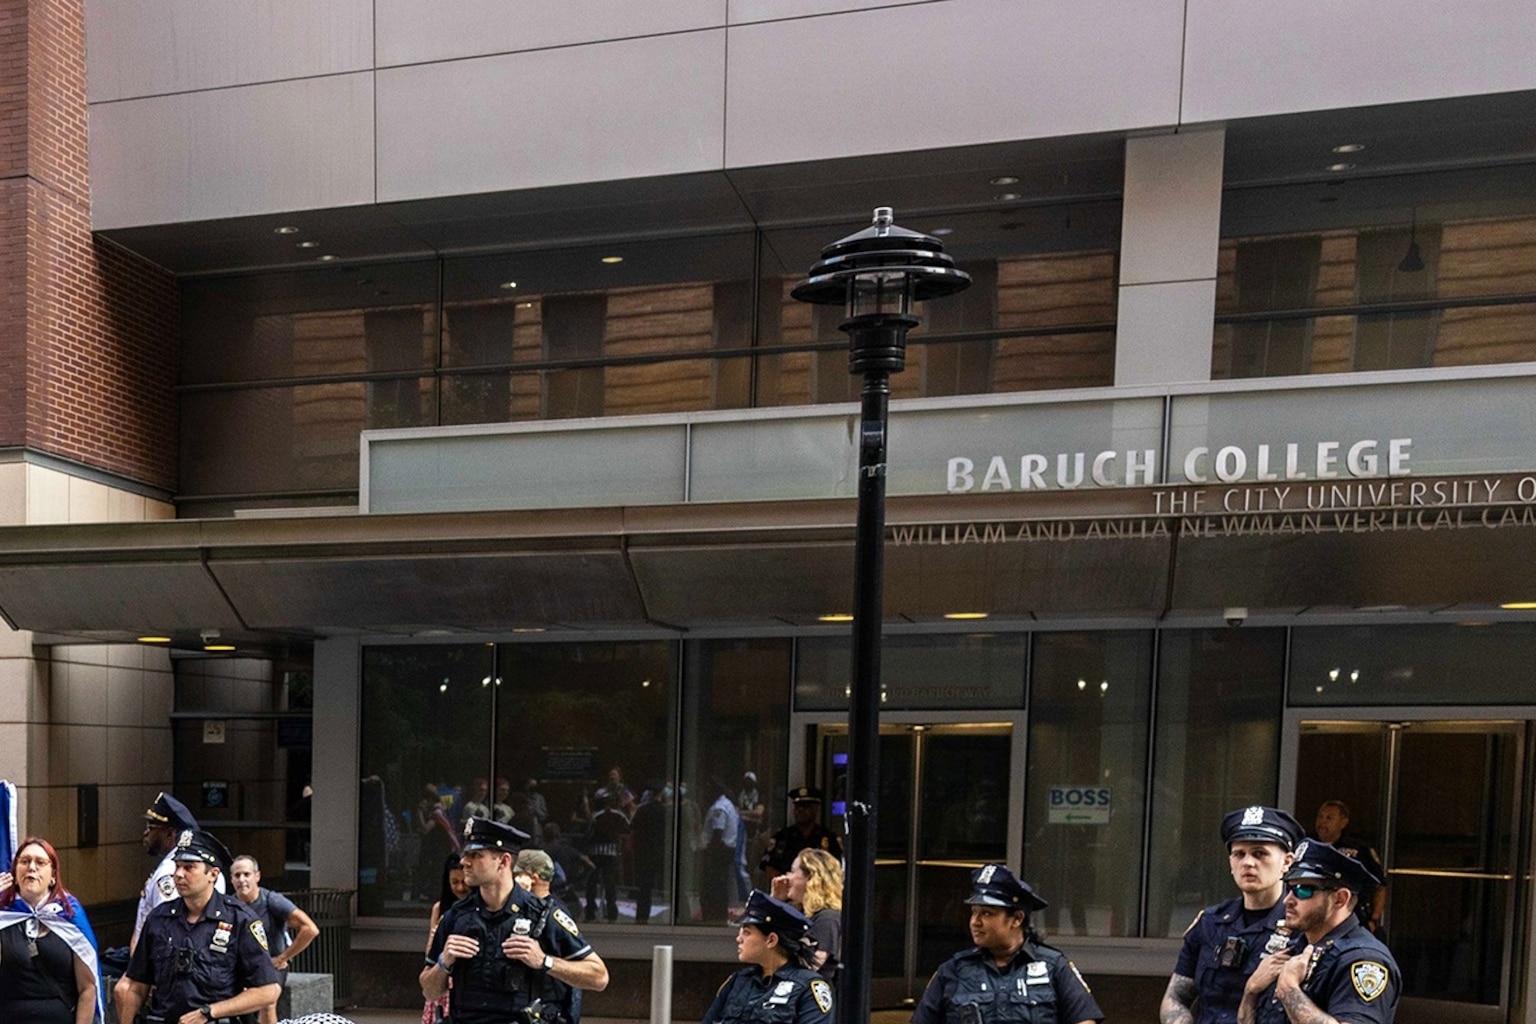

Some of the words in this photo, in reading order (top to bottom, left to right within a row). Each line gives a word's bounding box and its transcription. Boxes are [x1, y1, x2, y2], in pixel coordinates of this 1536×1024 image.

[946, 449, 1156, 494] BARUCH
[1183, 437, 1413, 484] COLLEGE
[1152, 490, 1206, 515] THE
[1223, 486, 1291, 513] CITY
[1307, 478, 1502, 511] UNIVERSITY
[1517, 476, 1536, 502] O
[892, 523, 1007, 546] WILLIAM
[1015, 520, 1076, 543] AND
[1084, 517, 1169, 541] ANITA
[1179, 513, 1324, 539] NEWMAN
[1333, 507, 1465, 535] VERTICAL
[1050, 789, 1110, 806] BOSS
